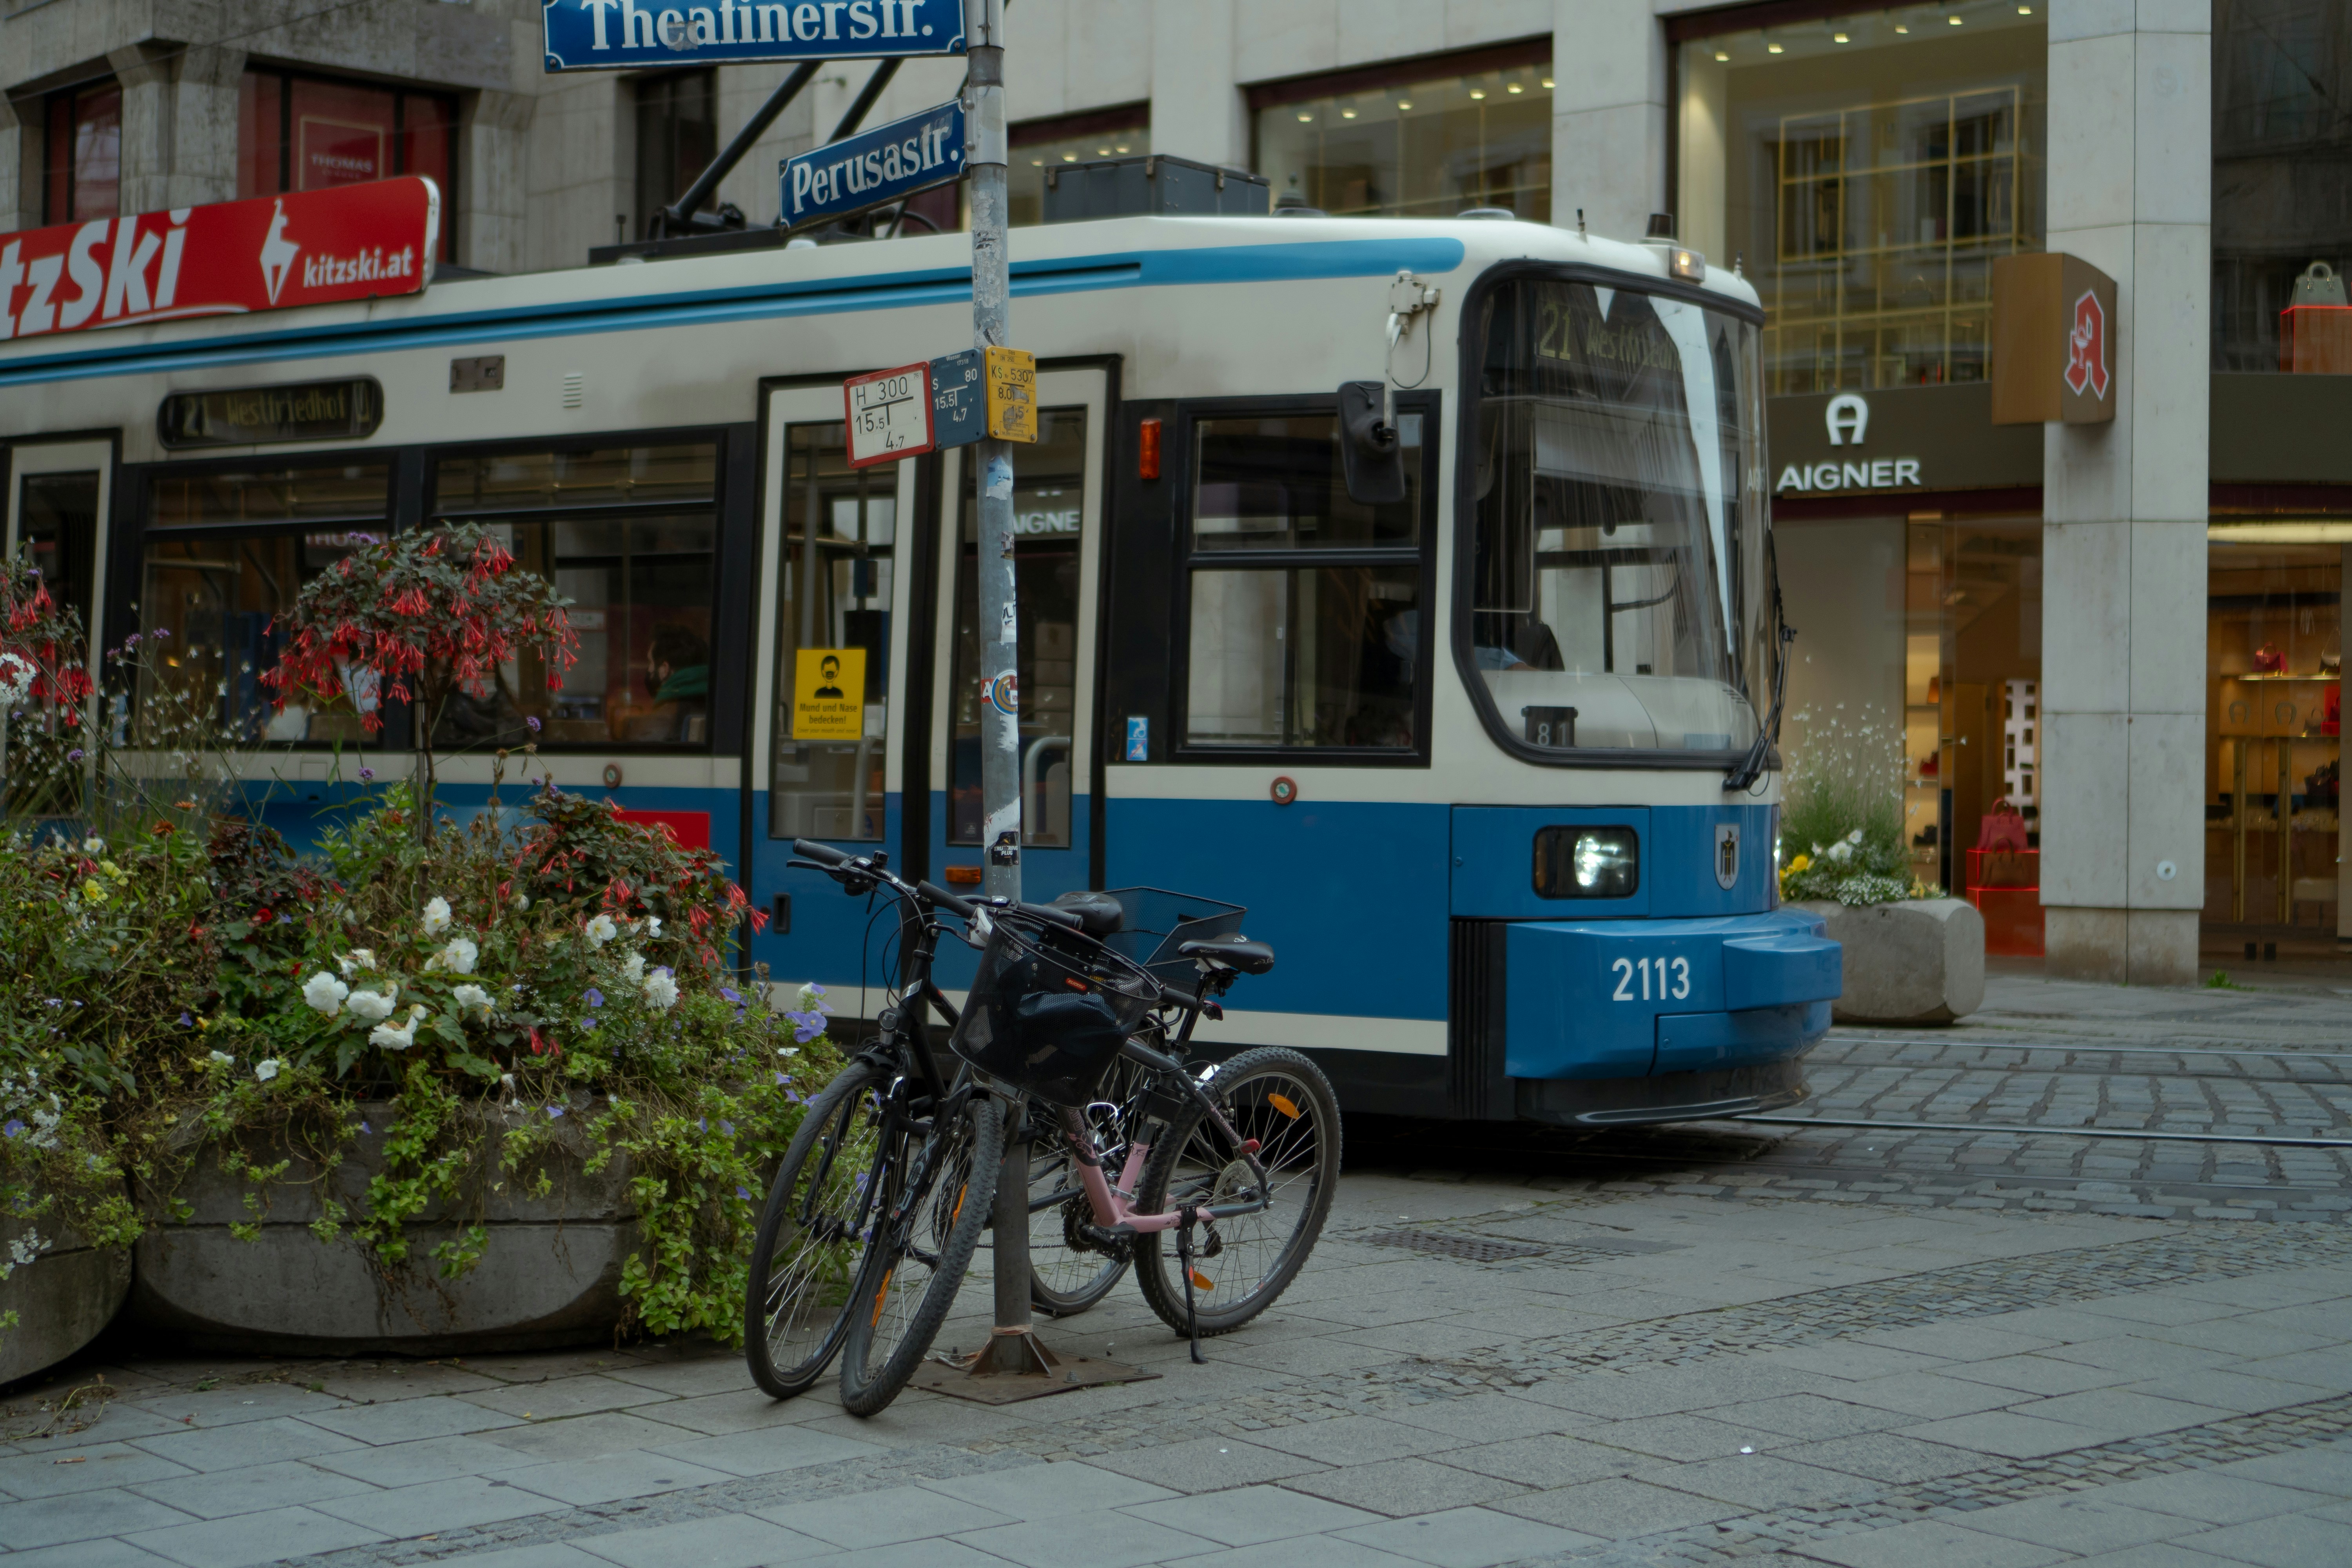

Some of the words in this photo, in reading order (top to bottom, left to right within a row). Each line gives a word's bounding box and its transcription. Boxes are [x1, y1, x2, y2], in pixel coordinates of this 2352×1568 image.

[581, 0, 934, 50] Theatinerstr.
[793, 123, 958, 214] Perusastr.
[303, 245, 413, 288] kitzski.at
[1539, 302, 1571, 361] 21
[933, 378, 939, 390] S
[965, 368, 977, 382] 80
[1011, 368, 1034, 383] 5307
[856, 386, 866, 406] H
[878, 376, 907, 401] 300
[935, 394, 954, 410] 15,5
[182, 396, 213, 437] 21
[855, 413, 885, 434] 15,5
[953, 407, 967, 423] 4,7
[886, 431, 904, 450] 4,7
[1775, 458, 1922, 492] AIGNER
[799, 702, 820, 712] Mund
[822, 703, 837, 712] und
[839, 703, 858, 713] Nase
[809, 715, 846, 724] bedecken!
[1537, 724, 1550, 746] 8
[1612, 957, 1690, 1001] 2113
